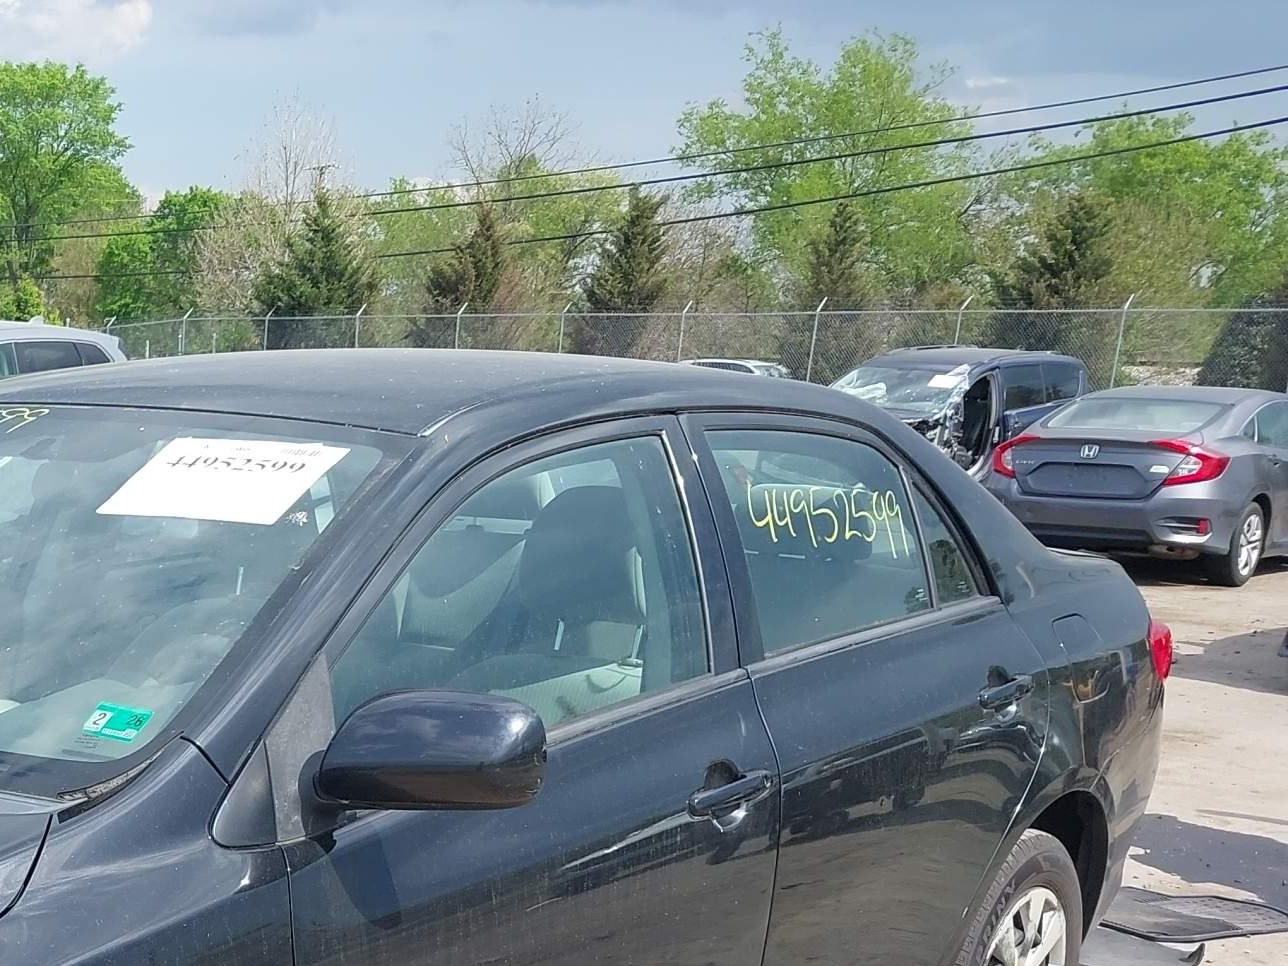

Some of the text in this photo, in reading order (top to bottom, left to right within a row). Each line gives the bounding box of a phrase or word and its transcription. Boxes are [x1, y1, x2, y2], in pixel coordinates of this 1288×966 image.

[746, 479, 910, 560] 44952599
[92, 712, 107, 726] 2
[126, 714, 145, 727] 26
